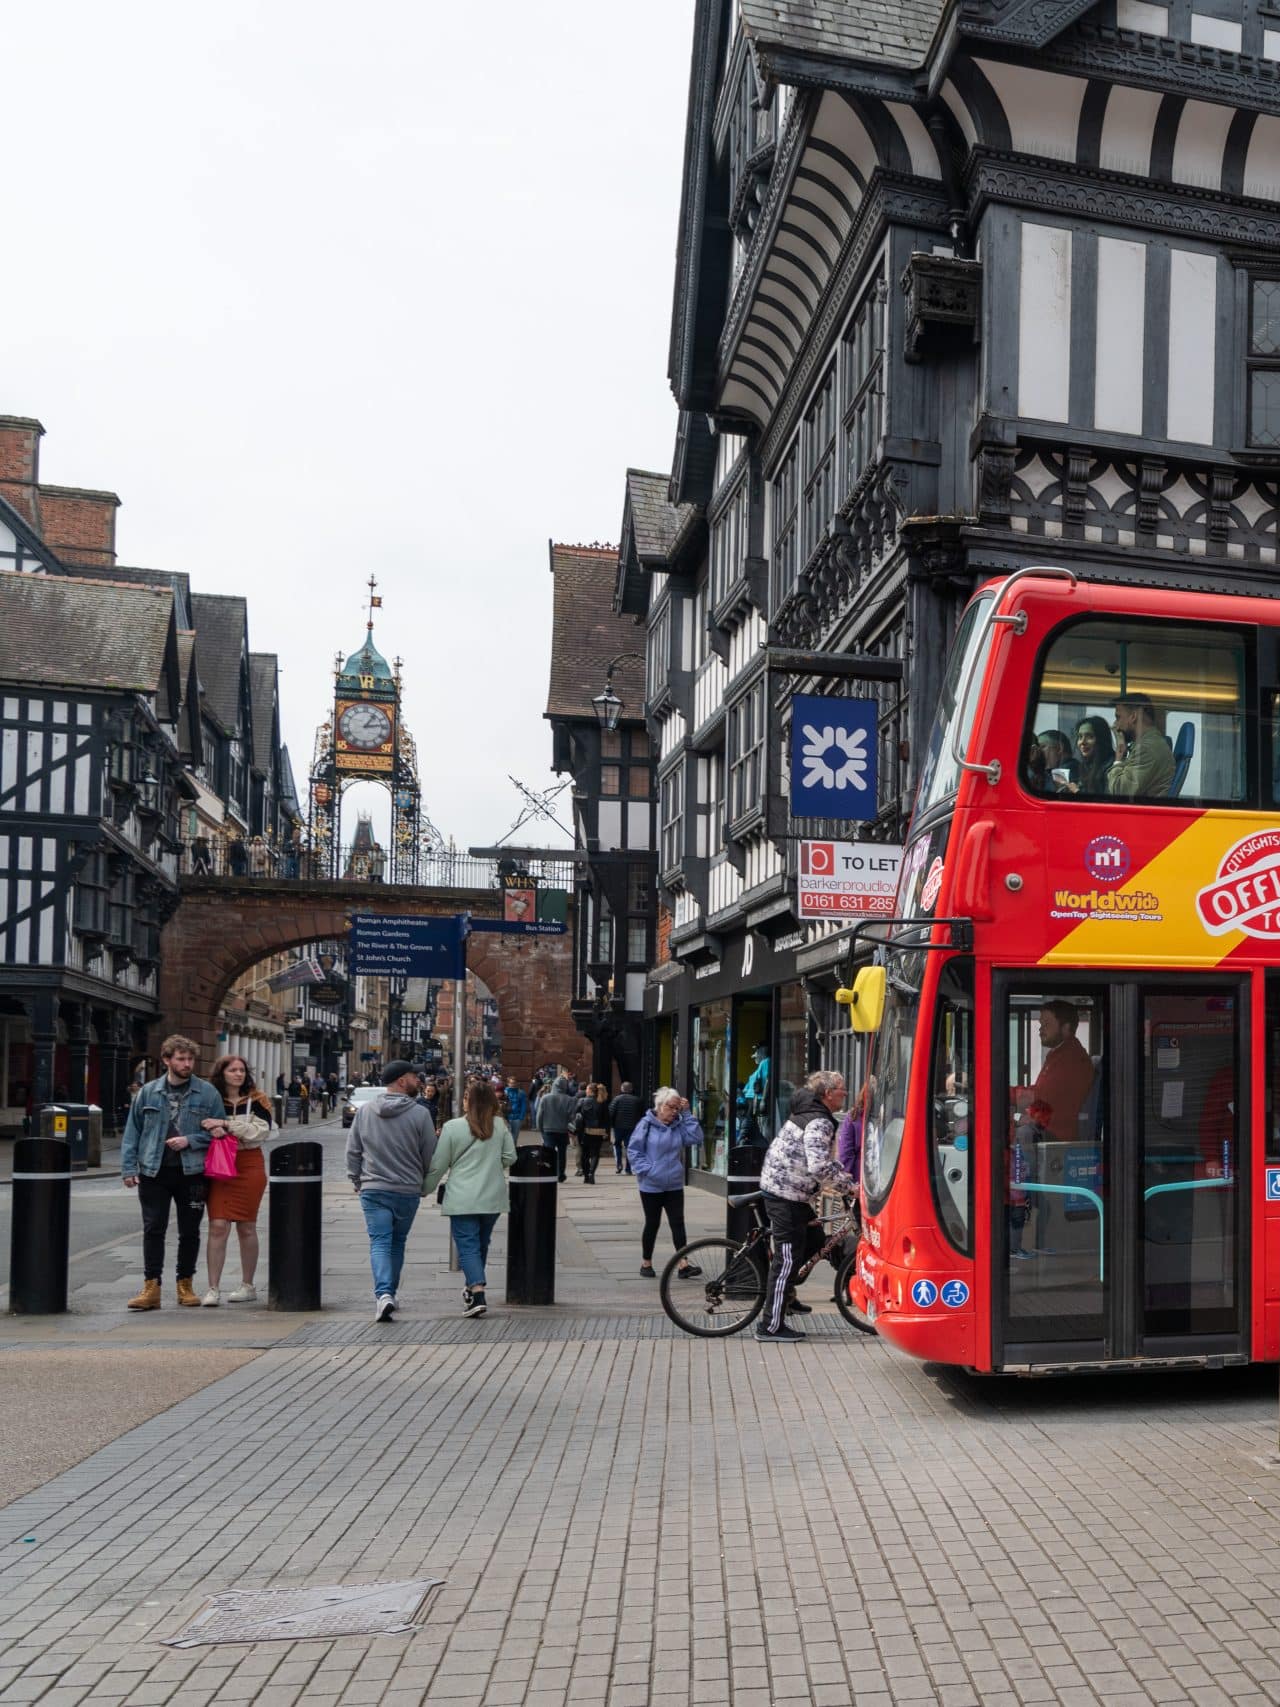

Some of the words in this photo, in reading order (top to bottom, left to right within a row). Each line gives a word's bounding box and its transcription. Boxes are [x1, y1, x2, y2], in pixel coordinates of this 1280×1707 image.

[842, 856, 864, 871] TO
[870, 858, 899, 872] LET
[804, 894, 834, 908] 0161
[839, 895, 863, 909] 631
[1055, 890, 1159, 911] Worldwide
[357, 916, 381, 925] Roman
[383, 917, 428, 927] Amphitheatre
[357, 929, 379, 938] Roman
[381, 930, 410, 938] Gardens
[525, 924, 536, 932] Bus
[538, 925, 561, 933] Station
[357, 941, 369, 950] The
[371, 942, 390, 950] River
[396, 943, 408, 951] The
[409, 943, 433, 951] Groves
[387, 954, 411, 963] Church
[356, 966, 390, 975] Grosvenor
[392, 967, 407, 975] Park
